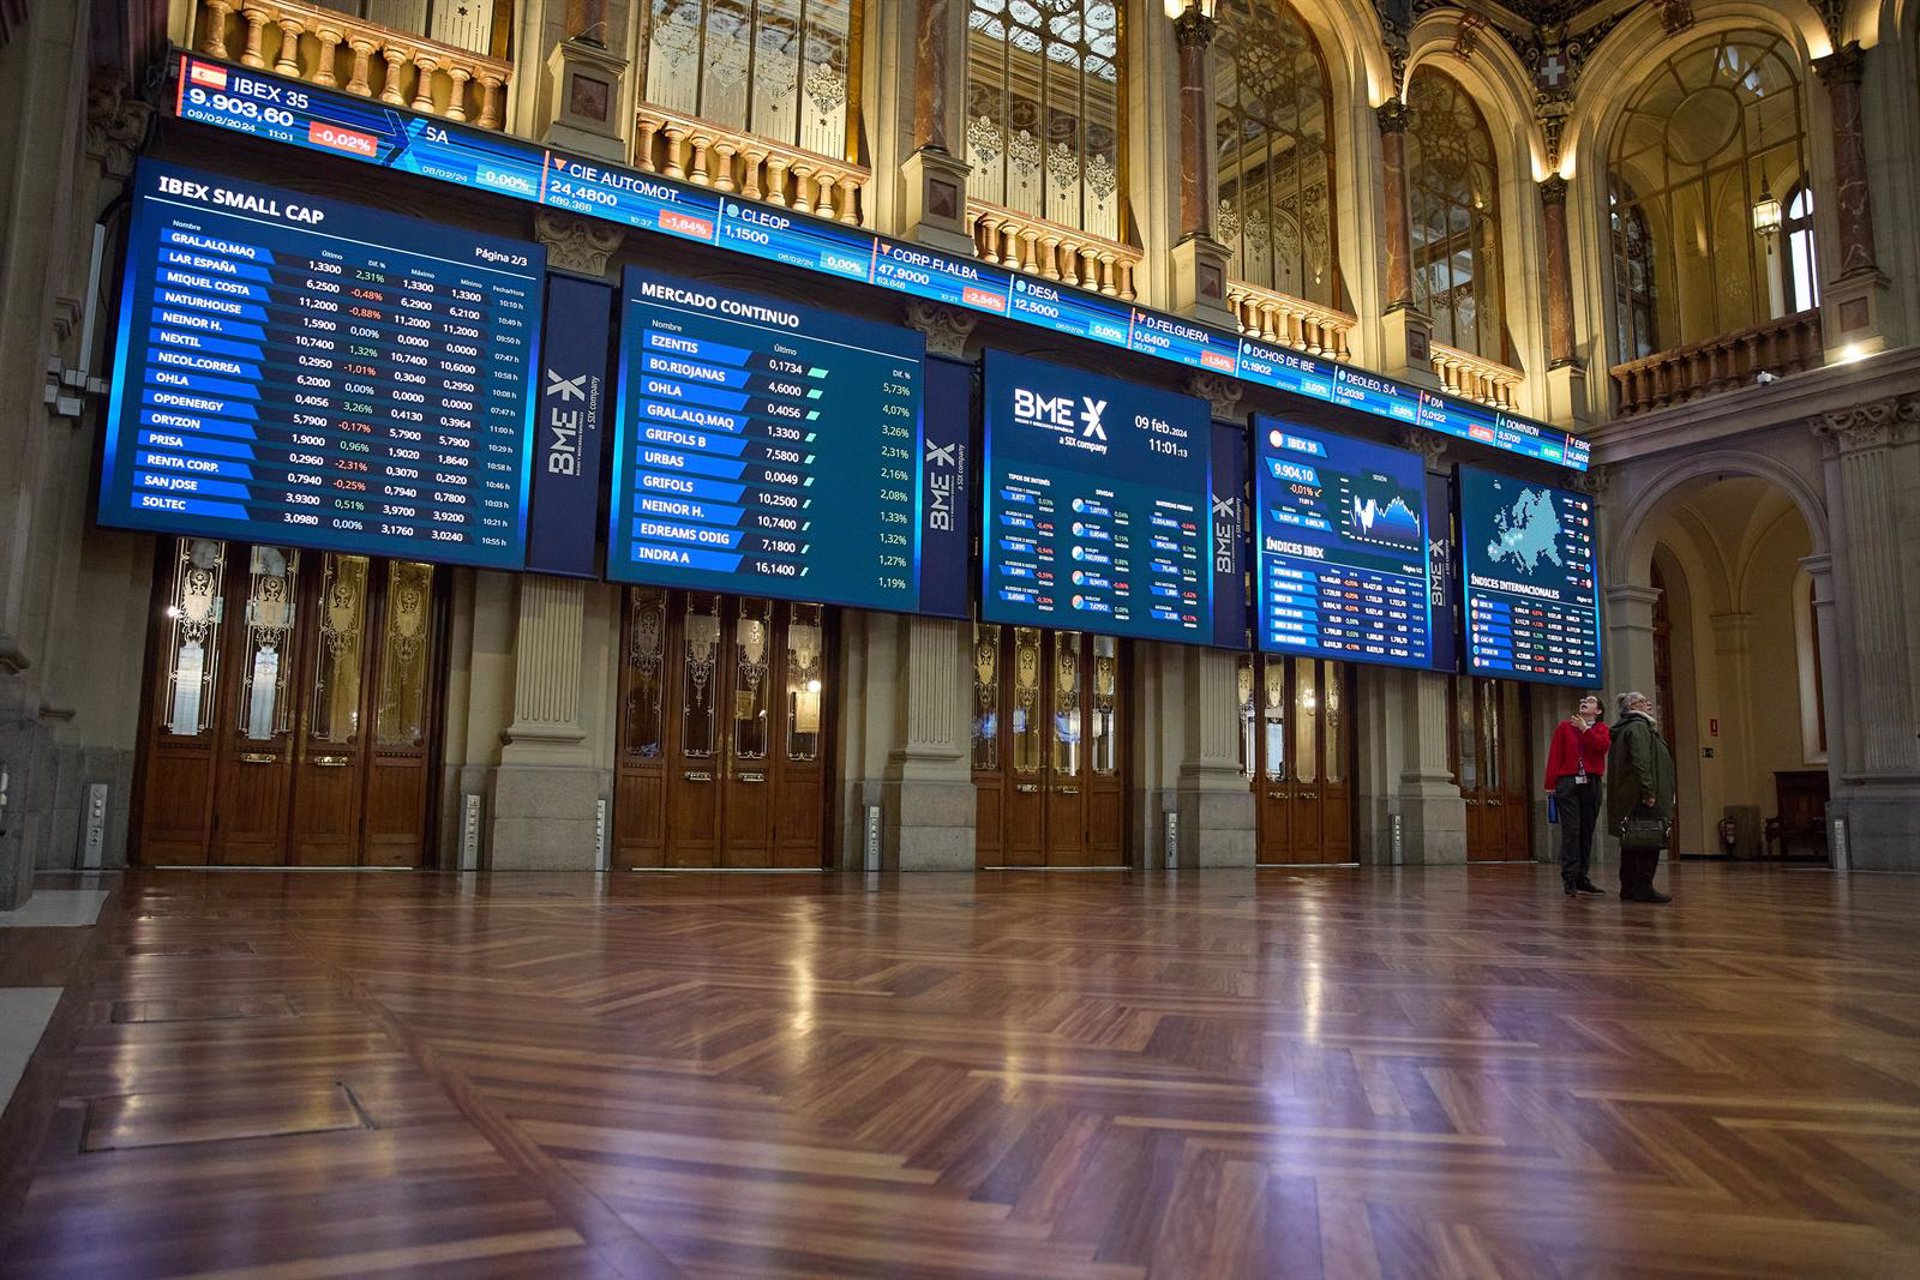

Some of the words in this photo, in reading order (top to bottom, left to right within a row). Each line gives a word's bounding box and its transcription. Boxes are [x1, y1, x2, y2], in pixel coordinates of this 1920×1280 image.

[190, 88, 293, 126] 9.903,60
[234, 77, 281, 102] IBEX
[286, 90, 308, 109] 35
[187, 109, 256, 131] 09/02/2024
[268, 129, 292, 141] 11:01
[316, 130, 371, 151] -0,02%
[426, 126, 448, 144] SA
[485, 171, 529, 191] 0,00%
[550, 179, 617, 206] 24,4800
[569, 163, 596, 182] CIE
[600, 172, 681, 203] AUTOMOT.
[158, 176, 209, 200] IBEX
[212, 188, 280, 216] SMALL
[285, 204, 324, 224] CAP
[666, 217, 706, 234] -1,84%
[725, 225, 768, 244] 1,1500
[741, 208, 789, 229] CLEOP
[309, 260, 341, 274] 1,3300
[355, 269, 384, 283] 2,31%
[475, 247, 509, 262] Página
[510, 254, 527, 266] 2/3
[827, 256, 860, 272] 0,00%
[878, 263, 929, 284] 47,9000
[169, 252, 191, 264] LAR
[193, 257, 236, 273] ESPAÑA
[306, 279, 340, 293] 6,2500
[350, 288, 382, 301] -0,48%
[1027, 284, 1059, 302] DESA
[167, 271, 212, 288] MIQUEL
[214, 281, 249, 295] COSTA
[299, 296, 338, 311] 11,2000
[349, 306, 381, 319] -0,88%
[641, 282, 717, 309] MERCADO
[720, 299, 799, 327] CONTINUO
[1014, 298, 1058, 317] 12,5000
[165, 292, 241, 314] NATURHOUSE
[303, 317, 336, 330] 1,5900
[350, 325, 379, 338] 0,00%
[1146, 316, 1208, 343] D.FELGUERA
[162, 312, 208, 328] NEINOR
[210, 320, 222, 330] H.
[295, 335, 334, 350] 10,7400
[349, 345, 378, 357] 1,32%
[652, 319, 682, 331] Nombre
[773, 343, 797, 355] Último
[1134, 330, 1169, 347] 0,6400
[160, 332, 200, 347] NEXTIL
[298, 355, 332, 368] 0,2950
[343, 364, 376, 376] -1,01%
[651, 334, 698, 353] EZENTIS
[769, 359, 802, 374] 0,1734
[883, 382, 910, 396] 5,73%
[1241, 359, 1271, 374] 0,1902
[1252, 346, 1284, 364] DCHOS
[1286, 355, 1298, 368] DE
[1300, 360, 1314, 372] IBE
[155, 372, 189, 385] OHLA
[294, 393, 329, 407] 0,4056
[343, 401, 373, 414] 3,26%
[296, 374, 330, 388] 6,2000
[344, 382, 374, 395] 0,00%
[589, 376, 600, 409] company
[650, 358, 725, 381] BO.RIOJANAS
[768, 381, 801, 396] 4,6000
[882, 404, 910, 417] 4,07%
[1336, 386, 1364, 400] 0,2035
[1430, 397, 1443, 407] DIA
[153, 393, 223, 411] OPDENERGY
[293, 413, 327, 426] 5,7900
[338, 421, 371, 433] -0,17%
[648, 381, 681, 396] OHLA
[767, 403, 800, 418] 0,4056
[882, 424, 909, 438] 3,26%
[1014, 388, 1074, 426] BME
[1134, 415, 1149, 429] 09
[151, 413, 200, 428] ORYZON
[292, 433, 325, 446] 1,9000
[339, 440, 369, 452] 0,96%
[548, 407, 577, 475] BME
[647, 404, 734, 430] GRAL.ALQ.MAQ
[767, 425, 800, 440] 1,3300
[881, 445, 909, 459] 2,31%
[1058, 436, 1064, 444] a
[1064, 436, 1076, 446] SIX
[1076, 440, 1107, 455] company
[1288, 438, 1305, 449] IBEX
[1307, 442, 1316, 452] 35
[149, 433, 183, 446] PRISA
[289, 453, 323, 465] 0,2960
[335, 459, 367, 471] -2,31%
[645, 428, 695, 445] GRIFOLS
[697, 436, 706, 447] B
[766, 447, 799, 462] 7,5800
[881, 467, 908, 480] 2,16%
[147, 454, 184, 467] RENTA
[186, 459, 218, 472] CORP.
[287, 472, 322, 485] 0,7940
[333, 479, 366, 491] -0,25%
[644, 451, 683, 467] URBAS
[764, 470, 798, 484] 0,0049
[880, 488, 907, 502] 2,08%
[1274, 463, 1313, 481] 9.904,10
[144, 475, 168, 487] SAN
[169, 478, 197, 490] JOSE
[285, 492, 320, 505] 3,9300
[334, 498, 364, 510] 0,51%
[642, 475, 693, 492] GRIFOLS
[759, 493, 797, 507] 10,2500
[880, 511, 907, 523] 1,33%
[930, 472, 949, 531] BME
[142, 496, 186, 510] SOLTEC
[283, 512, 318, 525] 3,0980
[332, 518, 362, 530] 0,00%
[642, 499, 689, 515] NEINOR
[691, 506, 704, 517] H.
[758, 515, 796, 530] 10,7400
[880, 533, 906, 545] 1,32%
[641, 523, 697, 540] EDREAMS
[698, 530, 729, 544] ODIG
[762, 539, 795, 552] 7,1800
[879, 554, 906, 567] 1,27%
[1217, 523, 1231, 573] BME
[1266, 536, 1302, 554] ÍNDICES
[1303, 545, 1323, 558] IBEX
[639, 547, 678, 561] INDRA
[680, 552, 690, 563] A
[755, 562, 795, 576] 16,1400
[879, 577, 905, 589] 1,19%
[1431, 562, 1443, 606] BME
[1470, 572, 1499, 588] ÍNDICES
[1499, 580, 1559, 599] INTERNACIONALES
